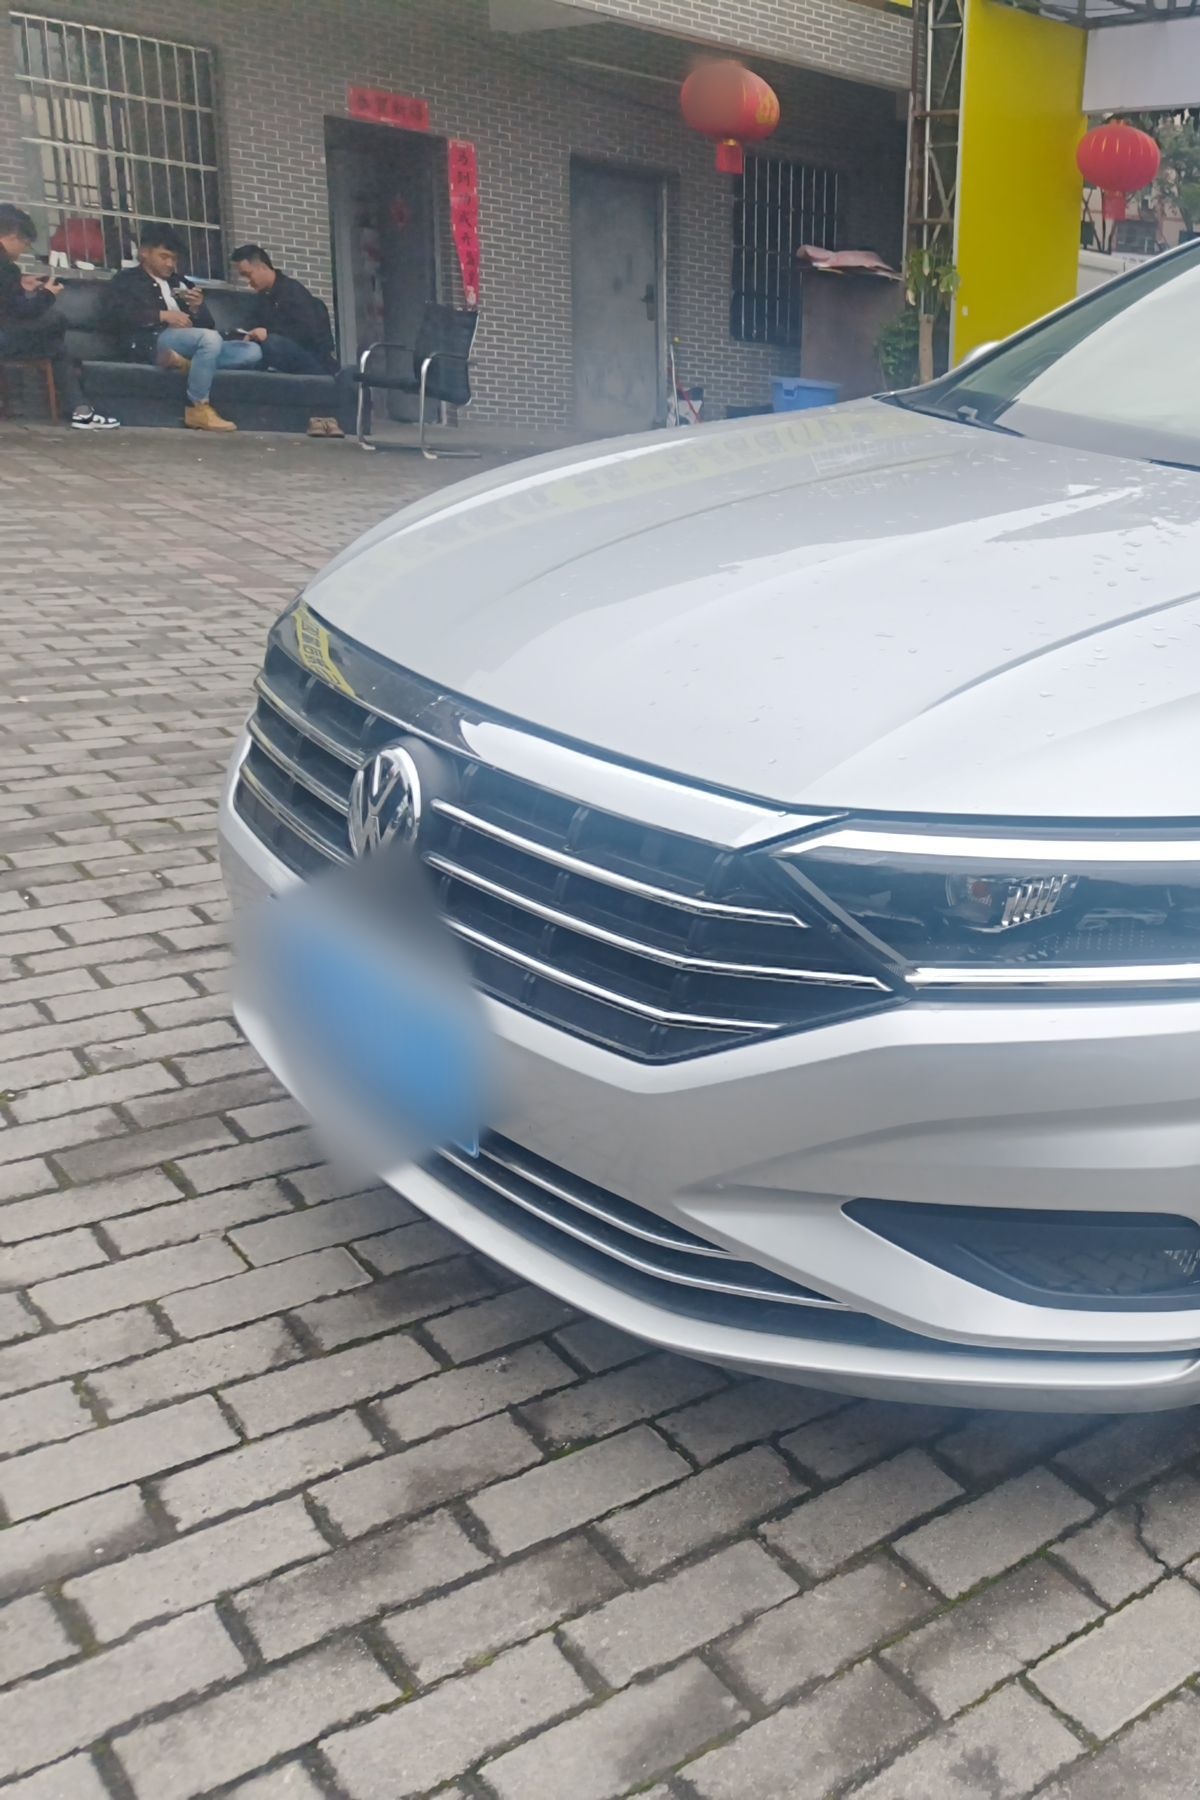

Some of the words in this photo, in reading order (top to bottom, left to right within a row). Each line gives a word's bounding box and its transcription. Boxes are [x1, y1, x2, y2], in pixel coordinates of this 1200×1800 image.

[456, 150, 475, 286] 马到功成开
